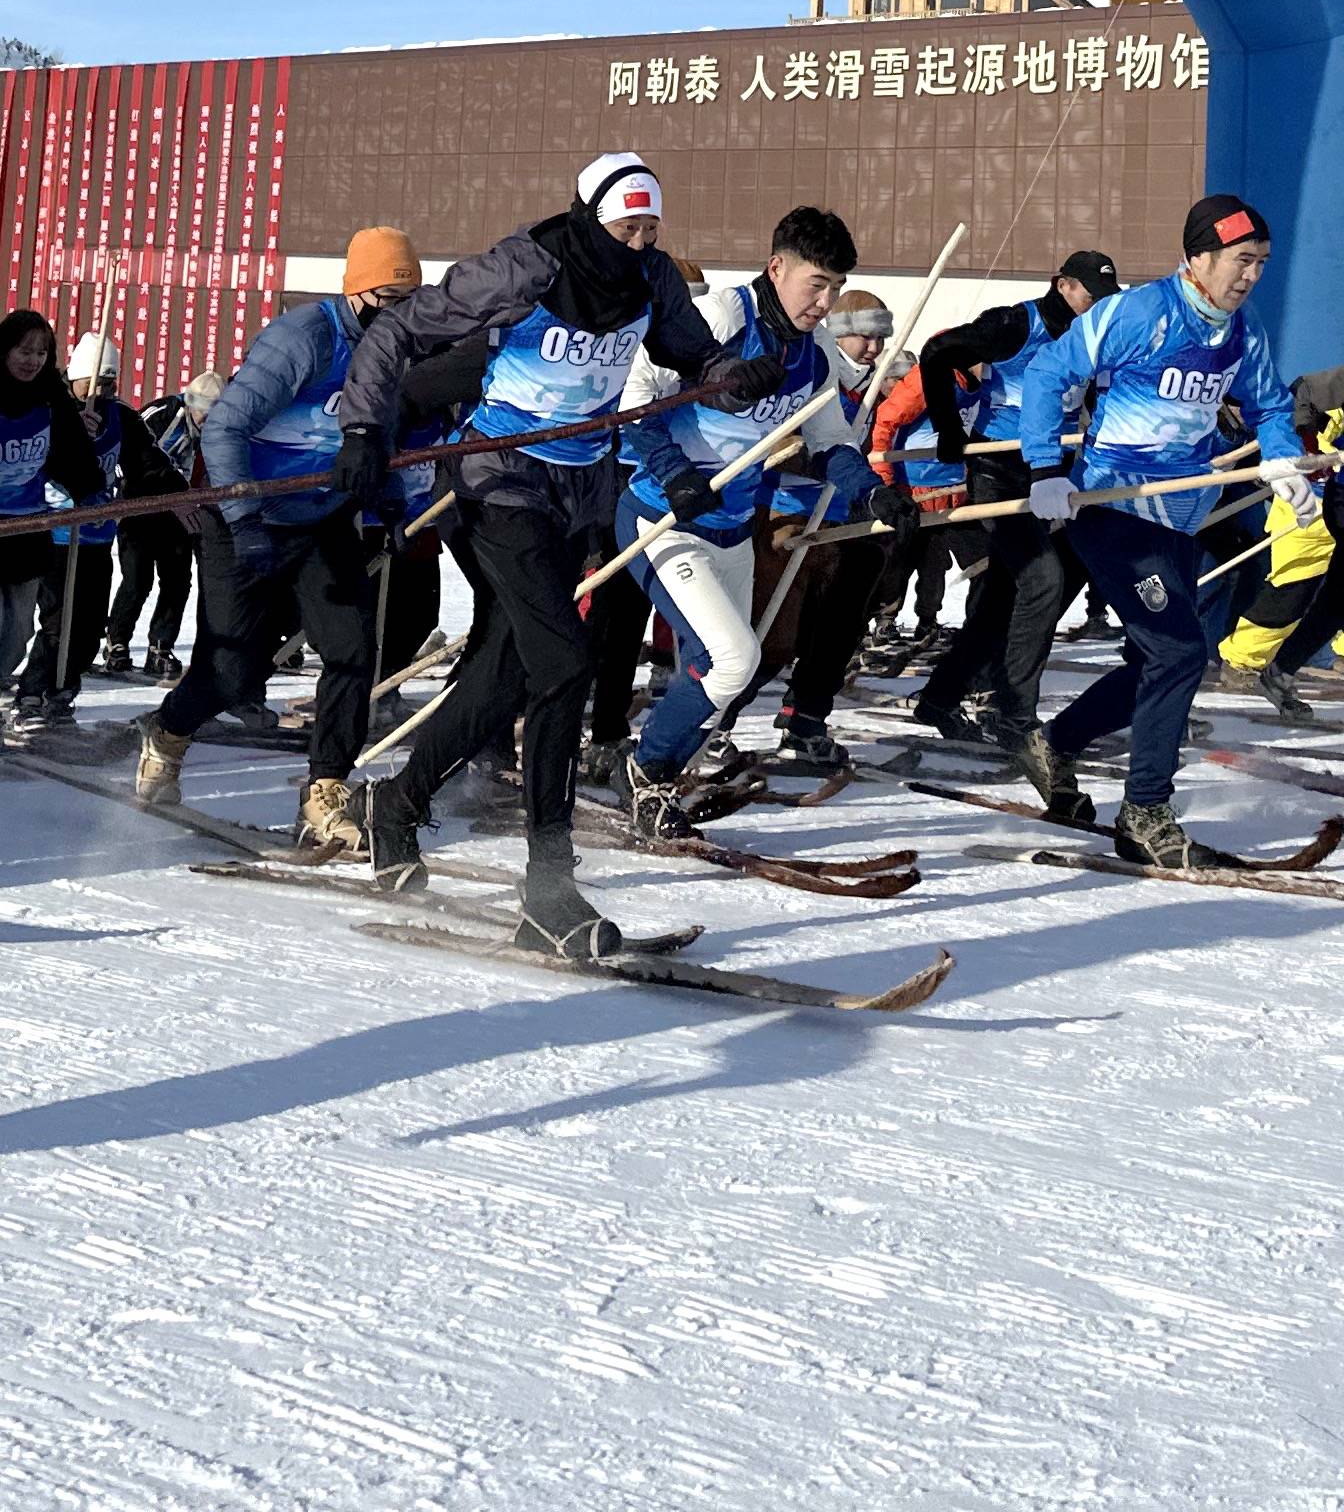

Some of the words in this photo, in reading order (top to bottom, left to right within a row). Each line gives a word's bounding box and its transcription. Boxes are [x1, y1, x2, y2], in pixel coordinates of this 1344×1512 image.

[608, 55, 720, 106] 阿勒泰
[740, 32, 1210, 102] 人类滑雪起源地博物馆
[539, 326, 639, 367] 0342
